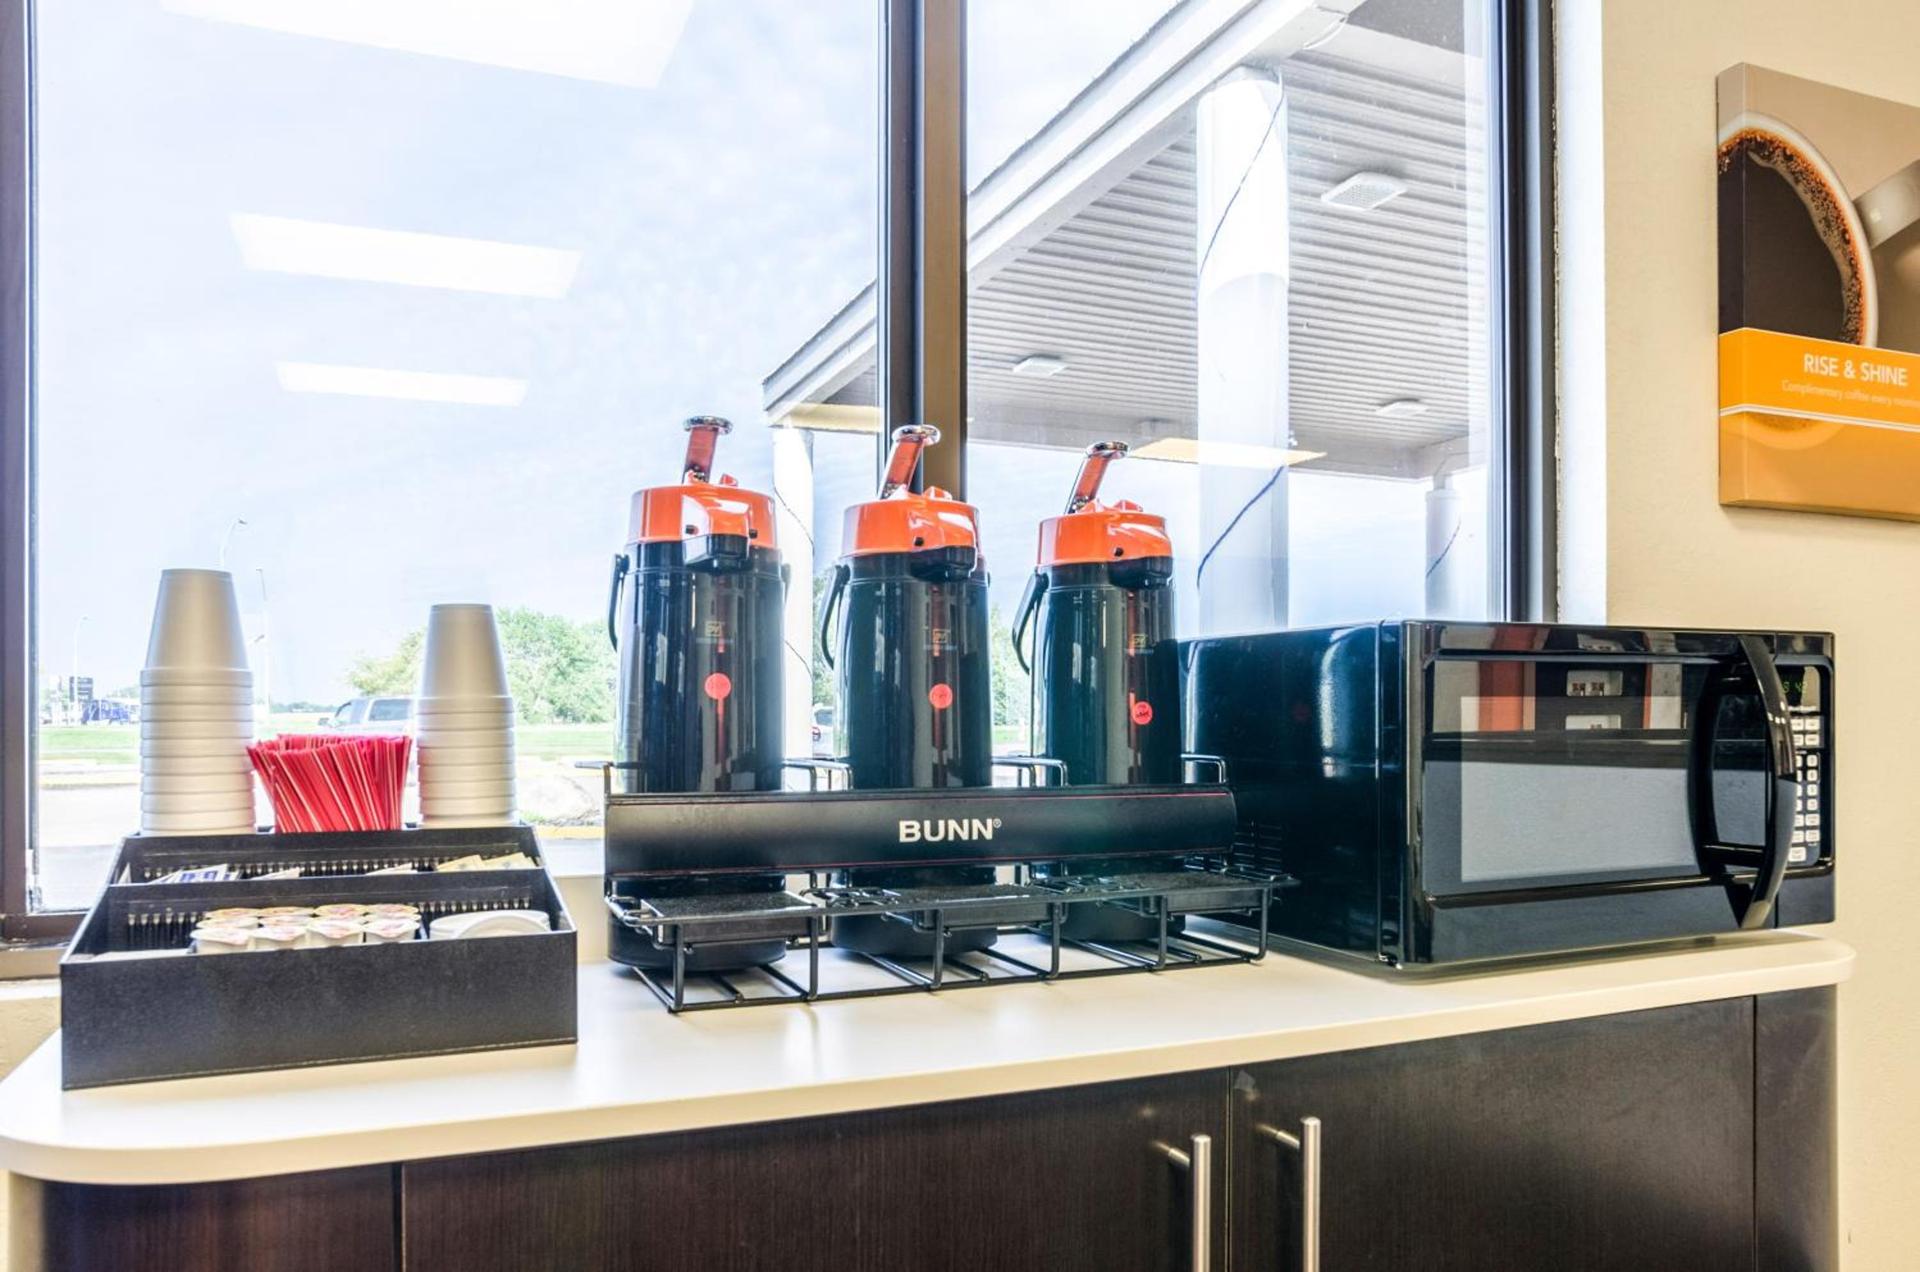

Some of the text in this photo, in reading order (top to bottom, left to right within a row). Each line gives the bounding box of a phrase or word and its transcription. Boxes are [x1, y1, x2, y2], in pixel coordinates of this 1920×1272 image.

[1803, 353, 1908, 386] RISE & SHINE
